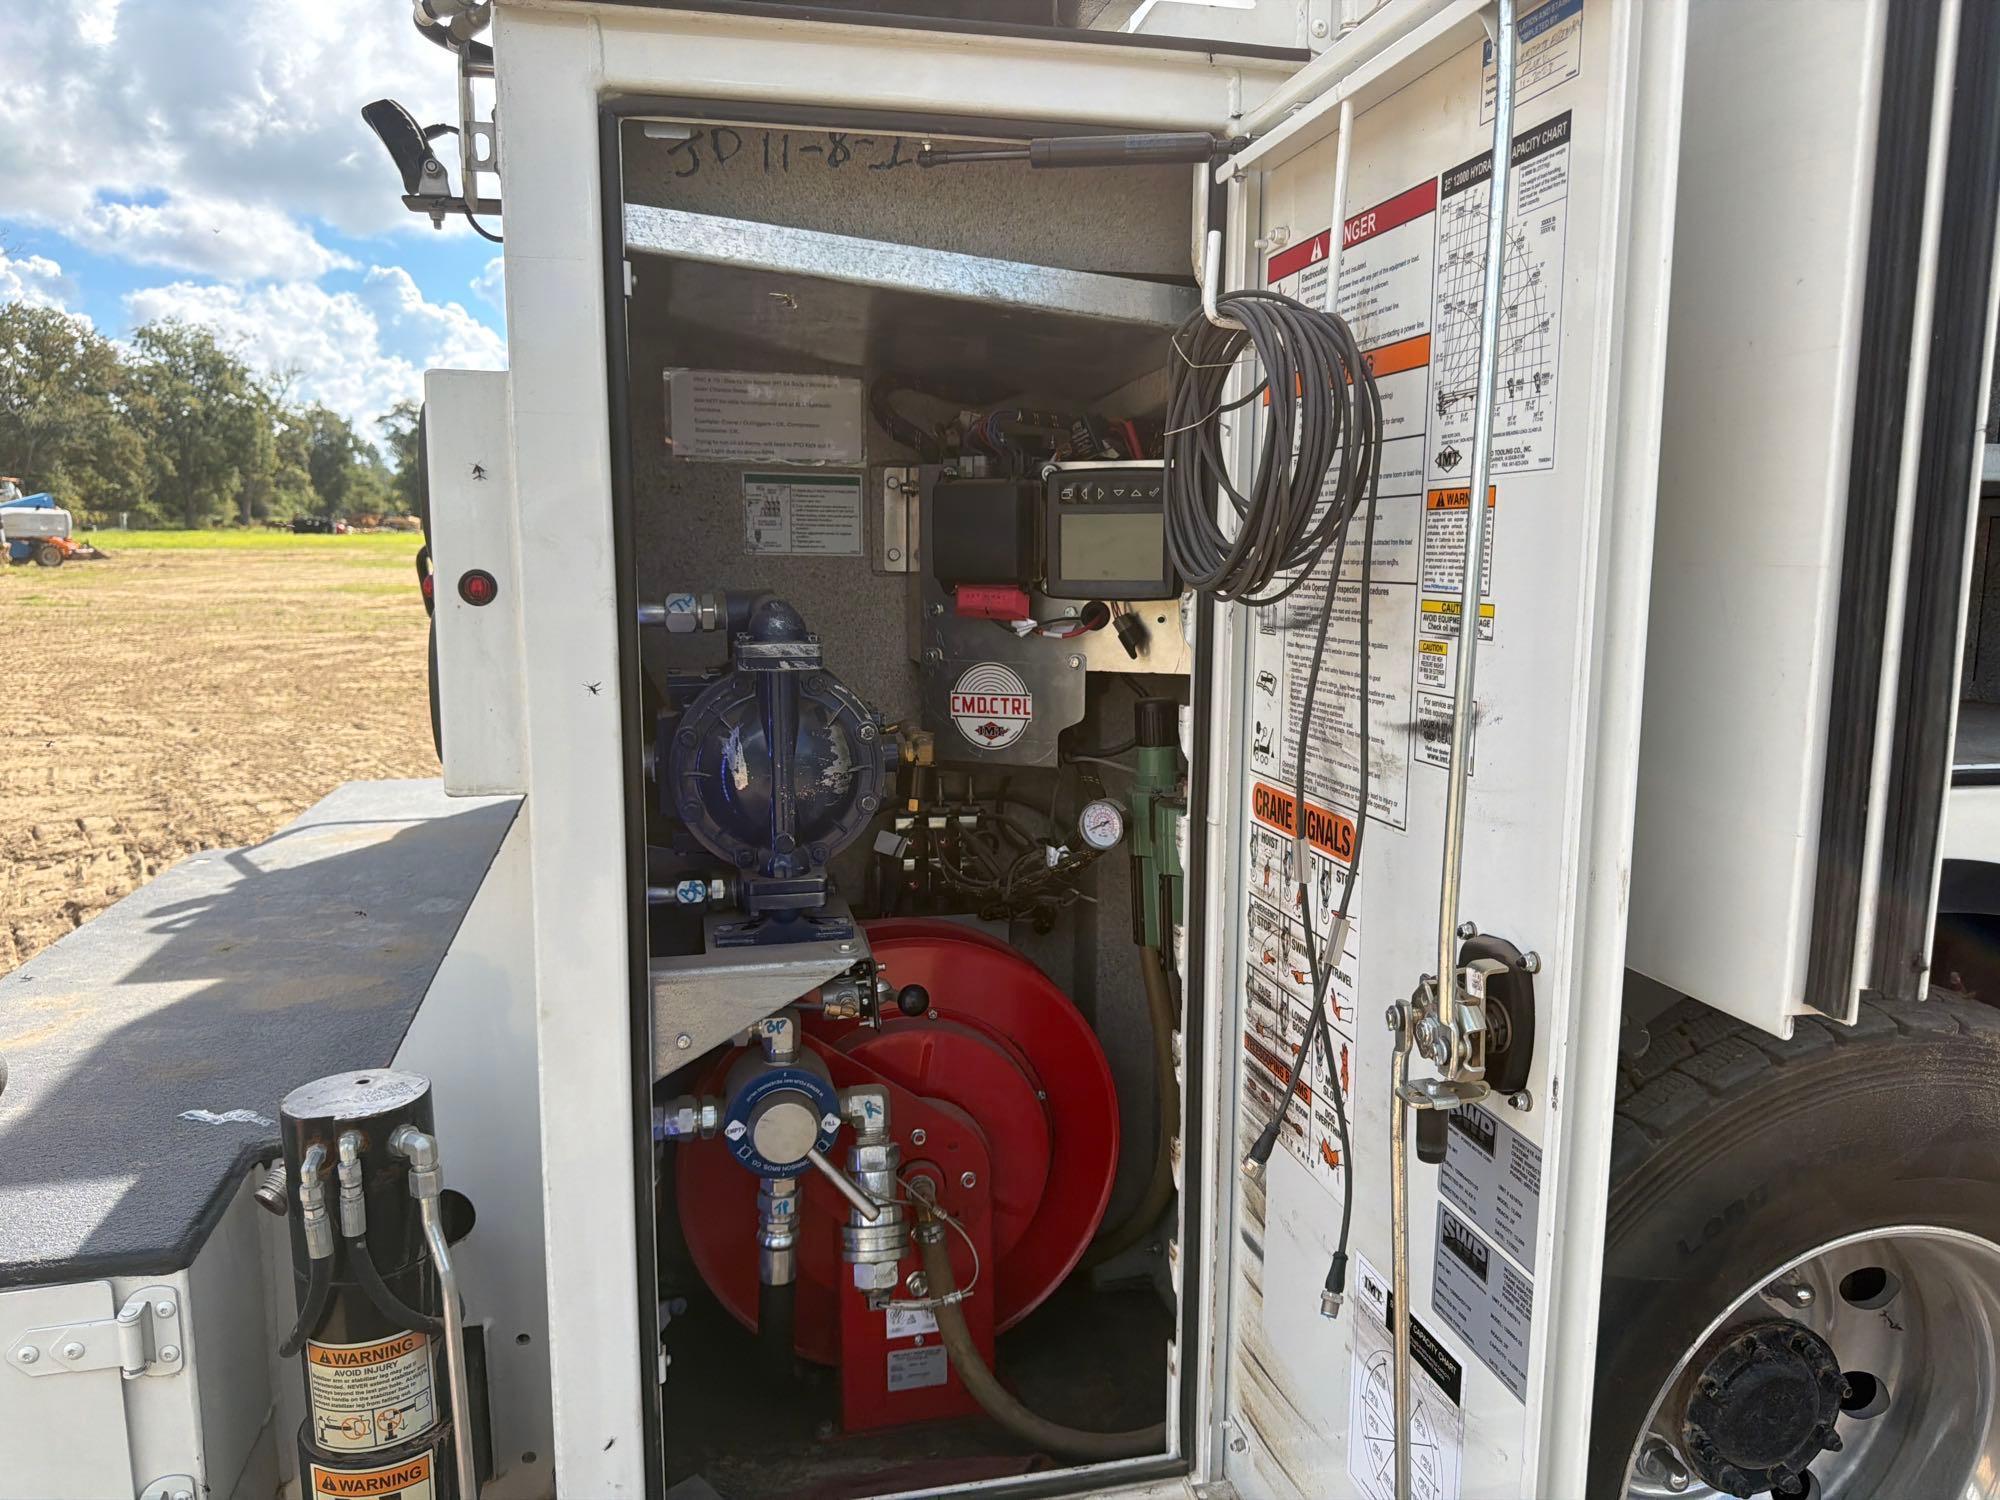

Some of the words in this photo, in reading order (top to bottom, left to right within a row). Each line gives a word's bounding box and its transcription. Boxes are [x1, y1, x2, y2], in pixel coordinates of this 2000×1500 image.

[1470, 158, 1492, 179] HYDRA
[1512, 133, 1541, 159] APACITY
[1542, 120, 1568, 145] CHART
[1344, 213, 1377, 245] NGER
[1495, 448, 1514, 456] TOOLING
[1447, 493, 1470, 506] WARN
[1369, 587, 1389, 596] cedures
[1442, 603, 1462, 613] CAUT
[1423, 614, 1437, 622] AVOID
[1438, 616, 1460, 625] EQUIPME
[1479, 620, 1491, 628] AGE
[1428, 623, 1442, 631] Check
[1423, 642, 1444, 652] CAUTION
[952, 696, 1031, 716] CMD.CTRL
[1431, 698, 1447, 708] service
[1433, 708, 1453, 720] equipme
[980, 725, 1005, 737] IMT
[1427, 753, 1450, 764] www.imt.
[1255, 788, 1293, 830] CRANE
[1303, 809, 1351, 858] IGNALS
[1261, 832, 1279, 850] HOIST
[1257, 917, 1271, 931] STOP
[1292, 939, 1309, 958] SWIN
[1291, 1010, 1309, 1028] LOWE
[726, 1126, 746, 1135] EMPTY
[1315, 1110, 1341, 1138] EVERYTHI
[1364, 1275, 1383, 1302] IMT
[332, 1338, 415, 1365] WARNING
[1413, 1325, 1439, 1354] CAPACITY
[1438, 1351, 1457, 1375] CHART
[334, 1369, 362, 1377] AVOID
[364, 1360, 399, 1375] INJURY
[351, 1375, 378, 1384] stabilizer
[389, 1369, 401, 1379] may
[370, 1379, 391, 1388] extend
[391, 1369, 417, 1381] stabilizer
[390, 1382, 404, 1390] hole.
[370, 1390, 397, 1401] stabilizer
[382, 1394, 400, 1404] falling
[339, 1465, 422, 1493] WARNING
